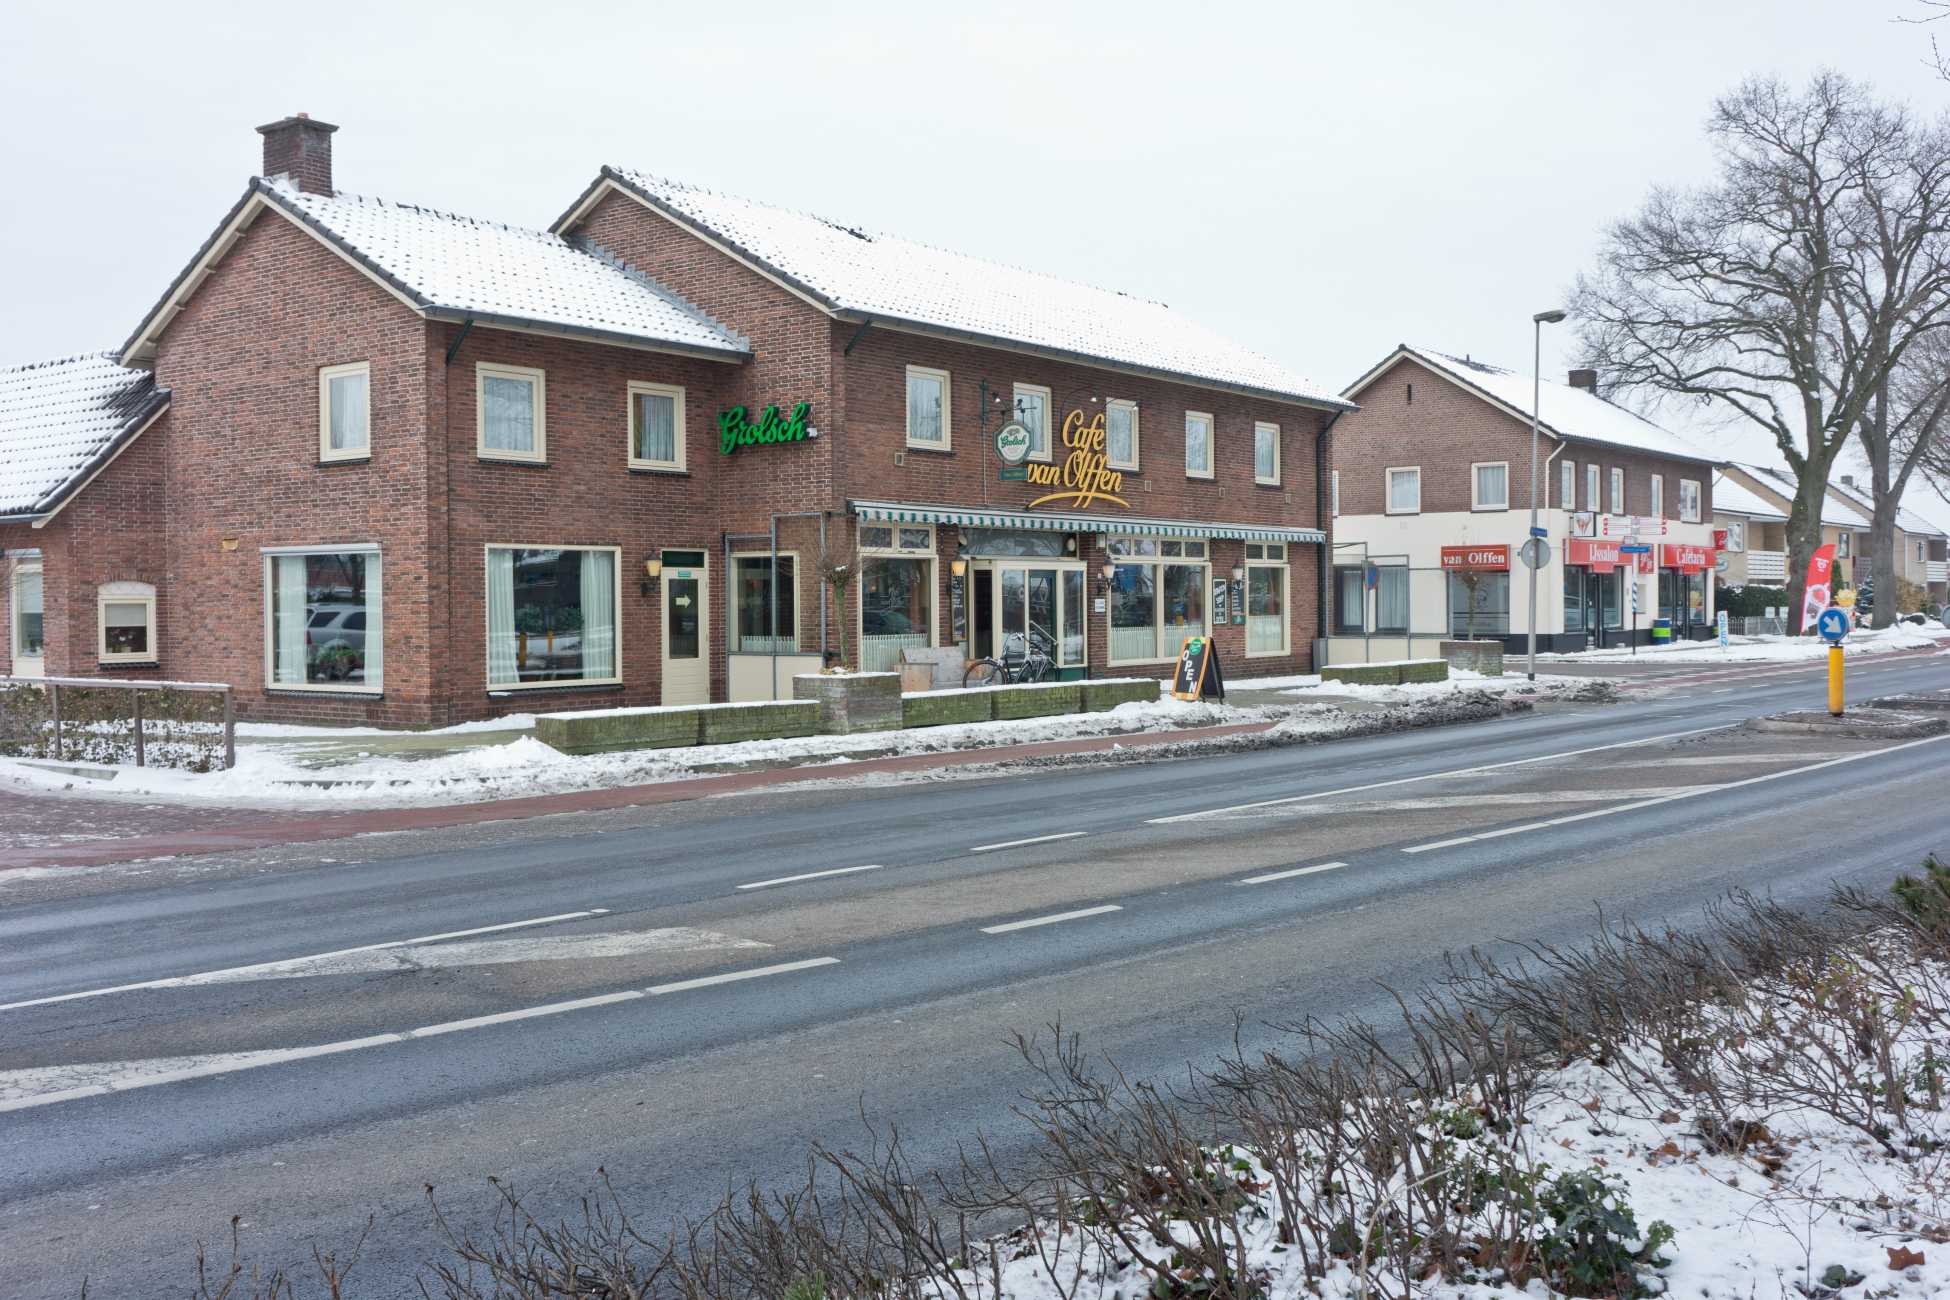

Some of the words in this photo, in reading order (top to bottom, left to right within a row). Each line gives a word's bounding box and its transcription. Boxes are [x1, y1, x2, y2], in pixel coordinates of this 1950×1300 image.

[719, 402, 810, 455] Grolsch
[1000, 435, 1027, 449] Grolsch
[1027, 463, 1060, 486] van
[1064, 450, 1122, 508] Olffen
[1443, 555, 1462, 564] van
[1468, 552, 1504, 564] Olffen
[1182, 650, 1198, 693] OPEN
